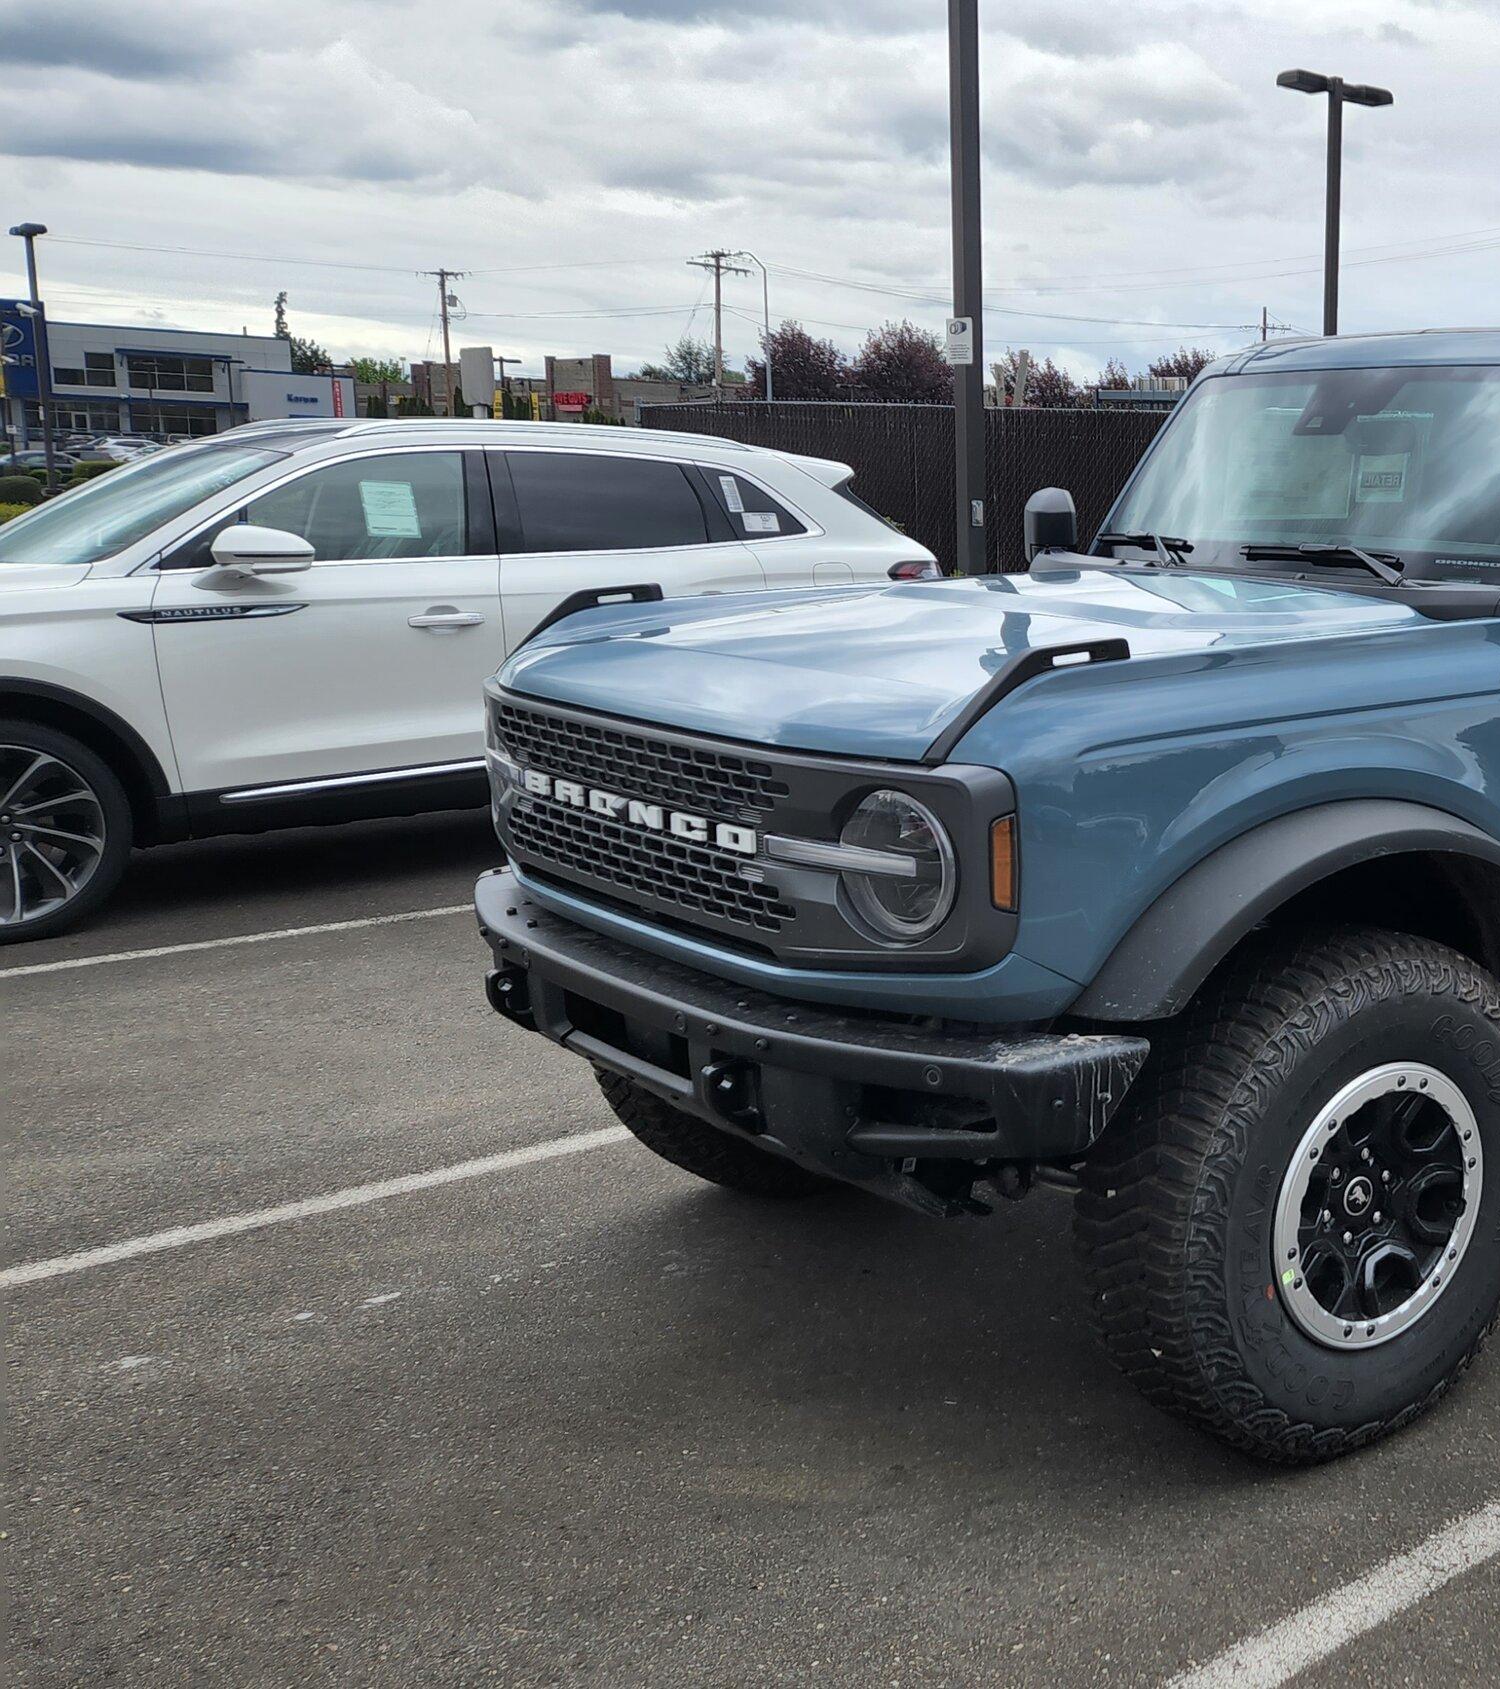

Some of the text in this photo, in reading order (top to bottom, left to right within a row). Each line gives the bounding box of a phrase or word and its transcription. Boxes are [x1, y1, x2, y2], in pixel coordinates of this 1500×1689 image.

[287, 393, 318, 403] Korum
[1434, 559, 1500, 568] BRONCO
[160, 607, 242, 617] NAUTILUS
[524, 769, 757, 854] BRONCO
